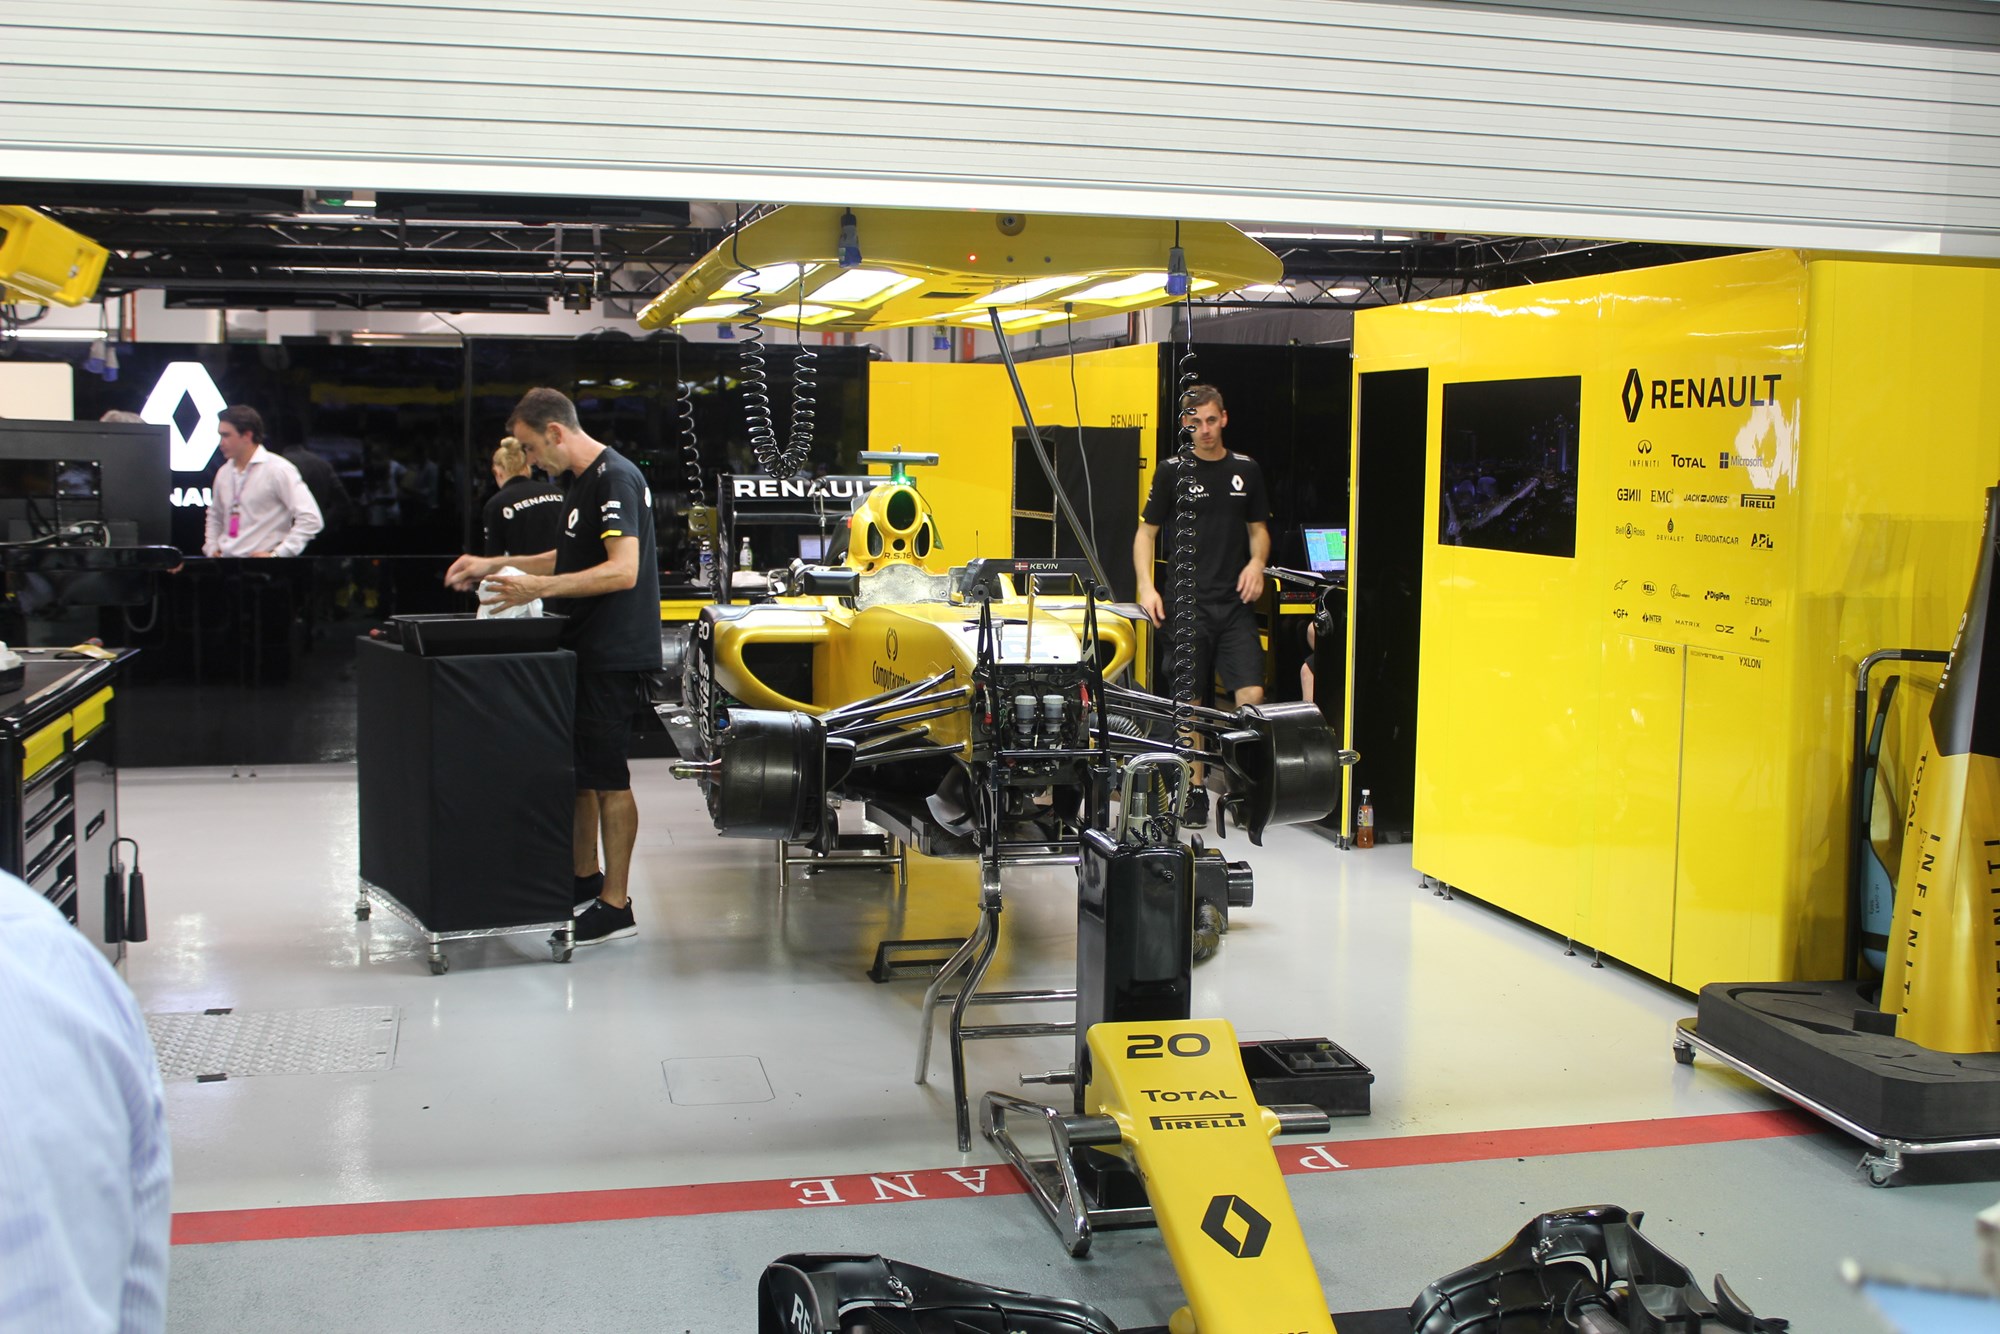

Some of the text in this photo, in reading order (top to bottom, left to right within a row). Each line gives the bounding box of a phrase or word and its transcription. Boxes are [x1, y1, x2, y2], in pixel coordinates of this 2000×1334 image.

[1651, 374, 1782, 409] RENAULT
[1629, 459, 1660, 468] INFINITI
[1671, 454, 1706, 469] TOTAL
[1730, 456, 1763, 468] Microsoft
[513, 494, 564, 511] RENAULT
[1740, 493, 1776, 509] PIRELLI
[1656, 534, 1685, 542] DEVIALET
[1695, 533, 1739, 545] EURODATACAR
[1643, 584, 1656, 592] BELL
[1675, 619, 1700, 629] MATRIX
[1654, 644, 1676, 655] SIEMENS
[1739, 656, 1761, 668] YXLON
[1126, 1033, 1211, 1059] 20
[1140, 1089, 1238, 1103] TOTAL
[1149, 1112, 1246, 1131] PIRELLI
